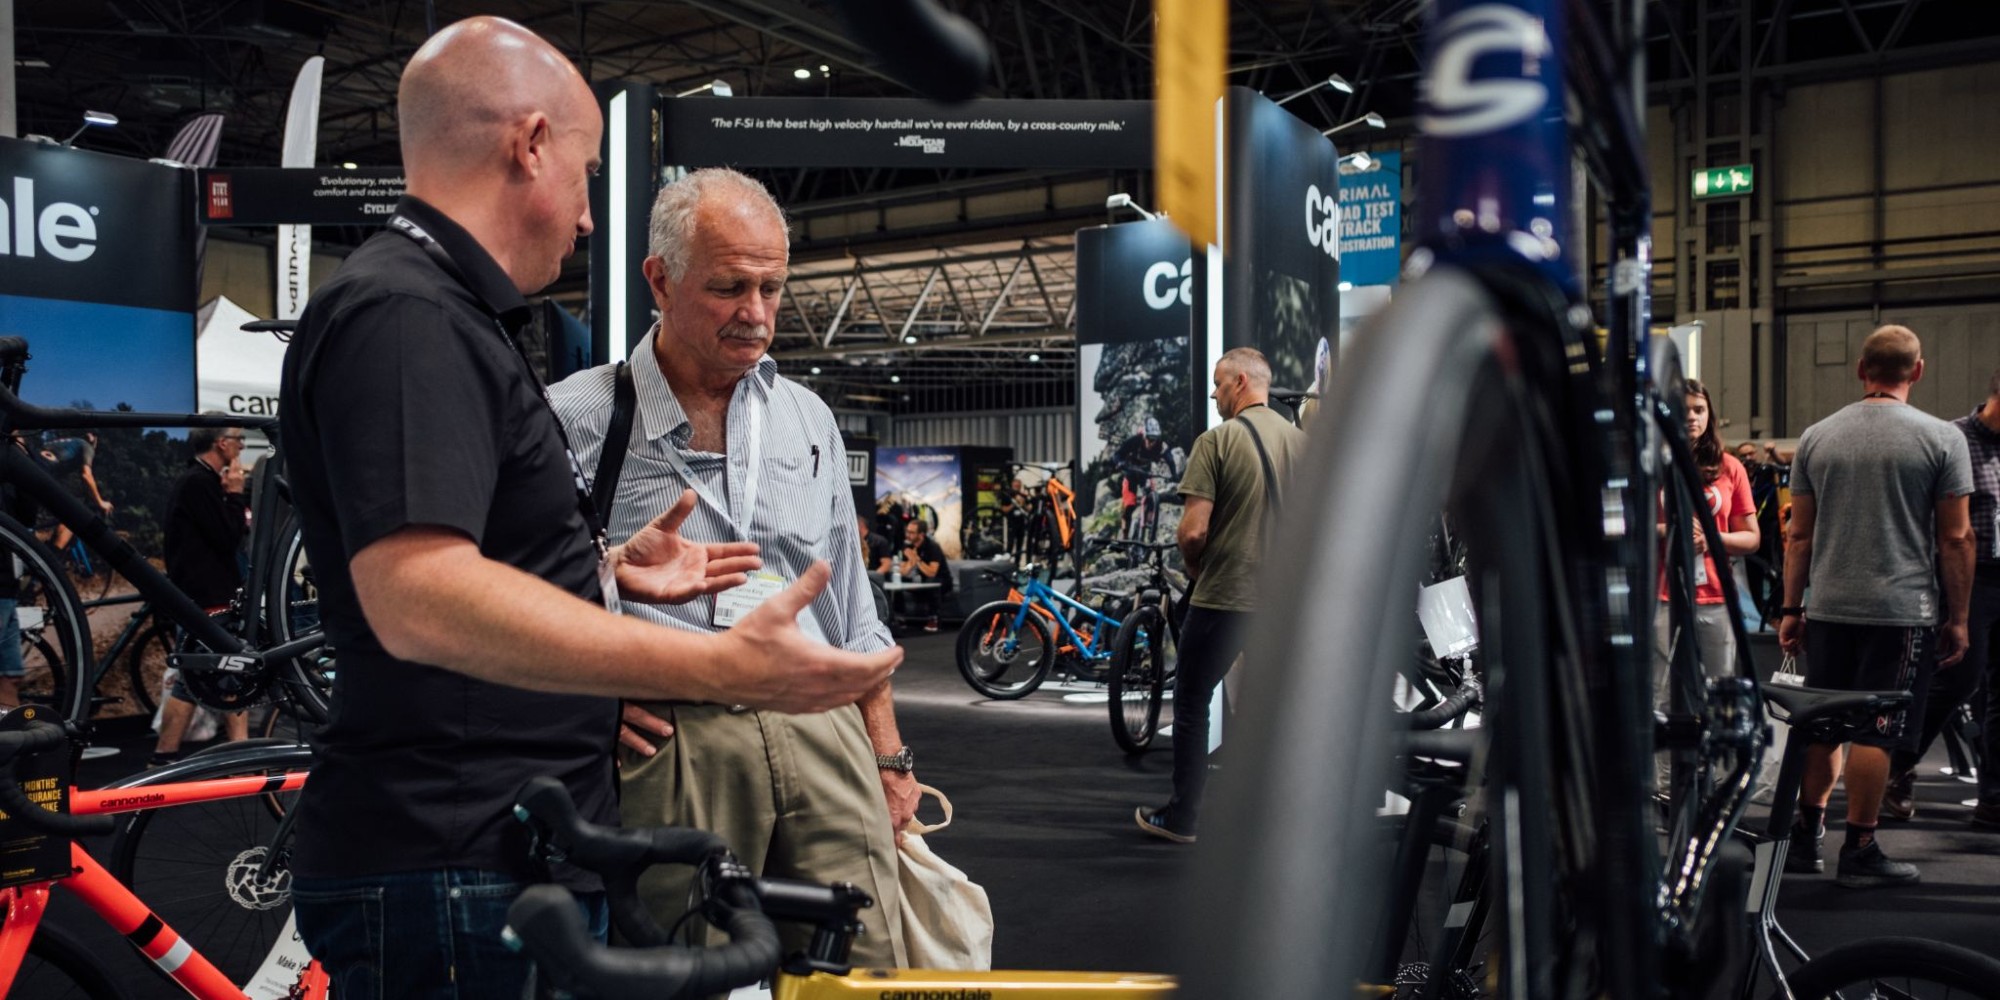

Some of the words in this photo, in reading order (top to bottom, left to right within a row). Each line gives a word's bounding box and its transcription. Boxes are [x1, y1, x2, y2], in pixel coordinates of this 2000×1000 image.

[734, 118, 754, 128] F-Si
[756, 118, 764, 128] is
[766, 118, 783, 128] the
[785, 118, 807, 128] best
[809, 118, 832, 132] high
[834, 118, 873, 132] velocity
[875, 119, 913, 129] hardtail
[915, 120, 944, 129] we've
[946, 121, 969, 129] ever
[970, 119, 1005, 131] ridden,
[1008, 120, 1020, 132] by
[1030, 120, 1097, 133] cross-country
[314, 187, 347, 197] comfort
[349, 187, 366, 197] and
[1365, 201, 1395, 218] TEST
[0, 176, 97, 262] le
[100, 793, 165, 808] cannondale
[880, 987, 992, 1000] cannondale
